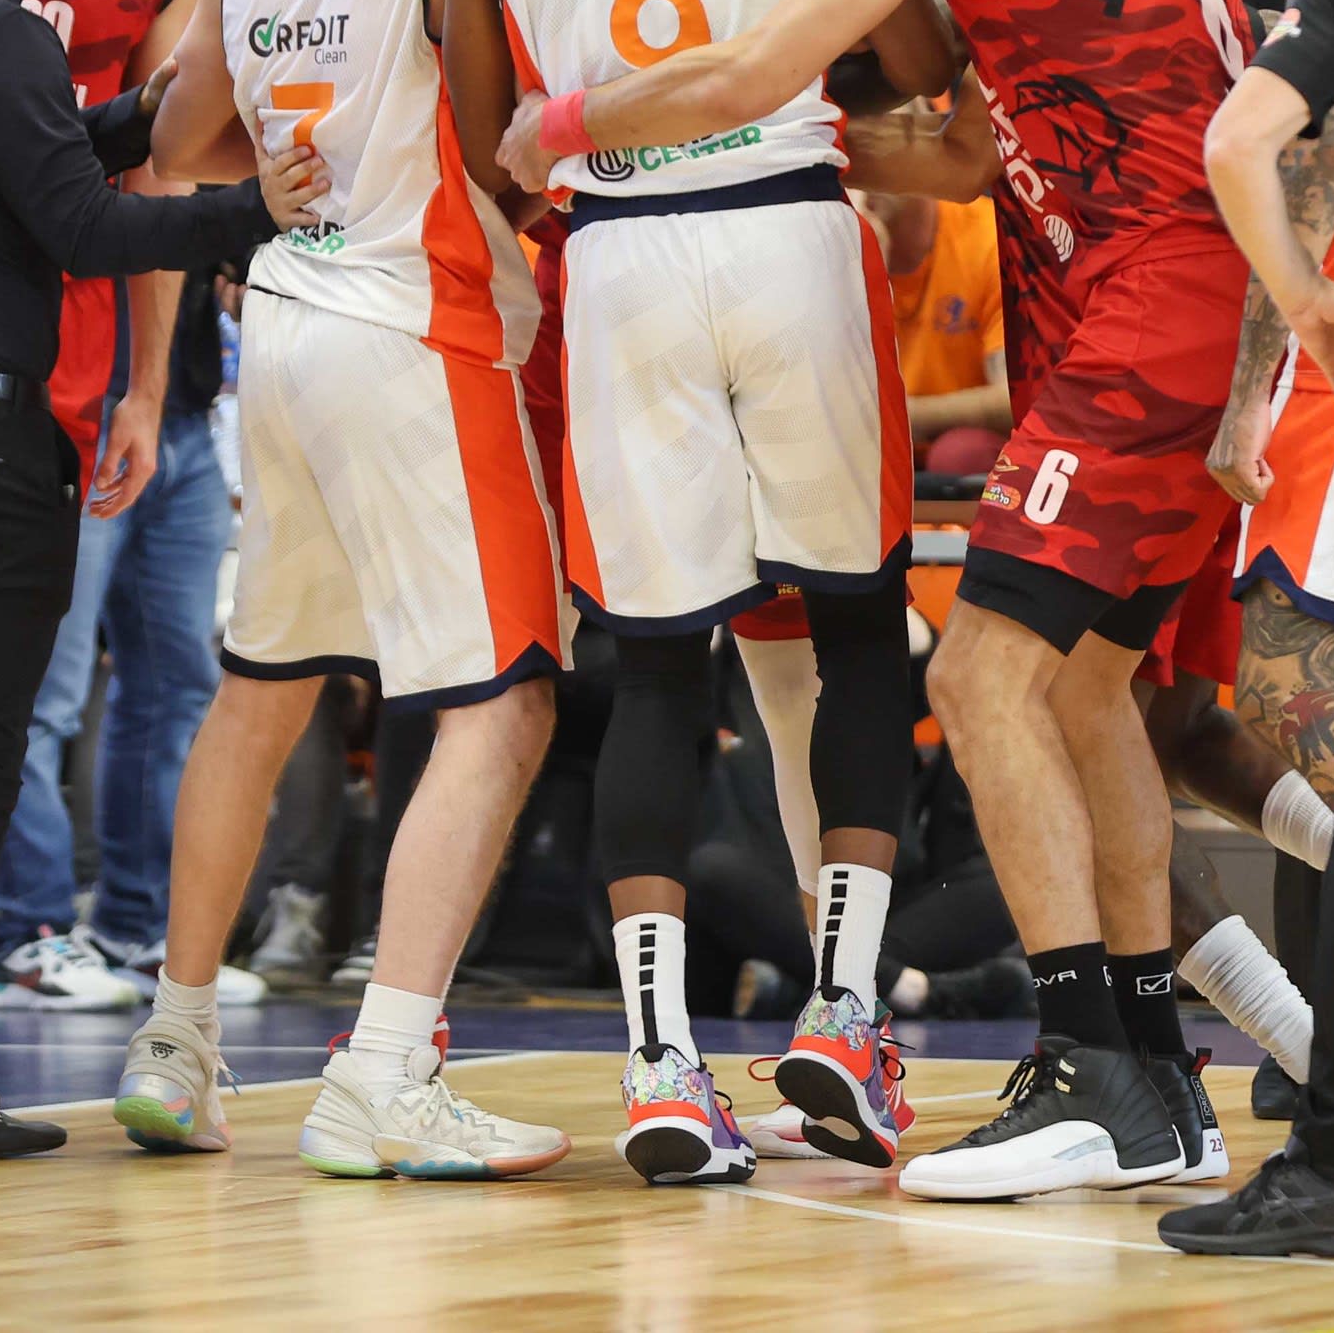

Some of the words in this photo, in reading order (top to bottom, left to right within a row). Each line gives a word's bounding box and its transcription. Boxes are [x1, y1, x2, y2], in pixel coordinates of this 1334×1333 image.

[314, 47, 347, 64] Clean
[270, 81, 335, 187] 7
[1024, 448, 1080, 525] 6
[1194, 1078, 1215, 1124] JORDAN
[1209, 1137, 1223, 1153] 23
